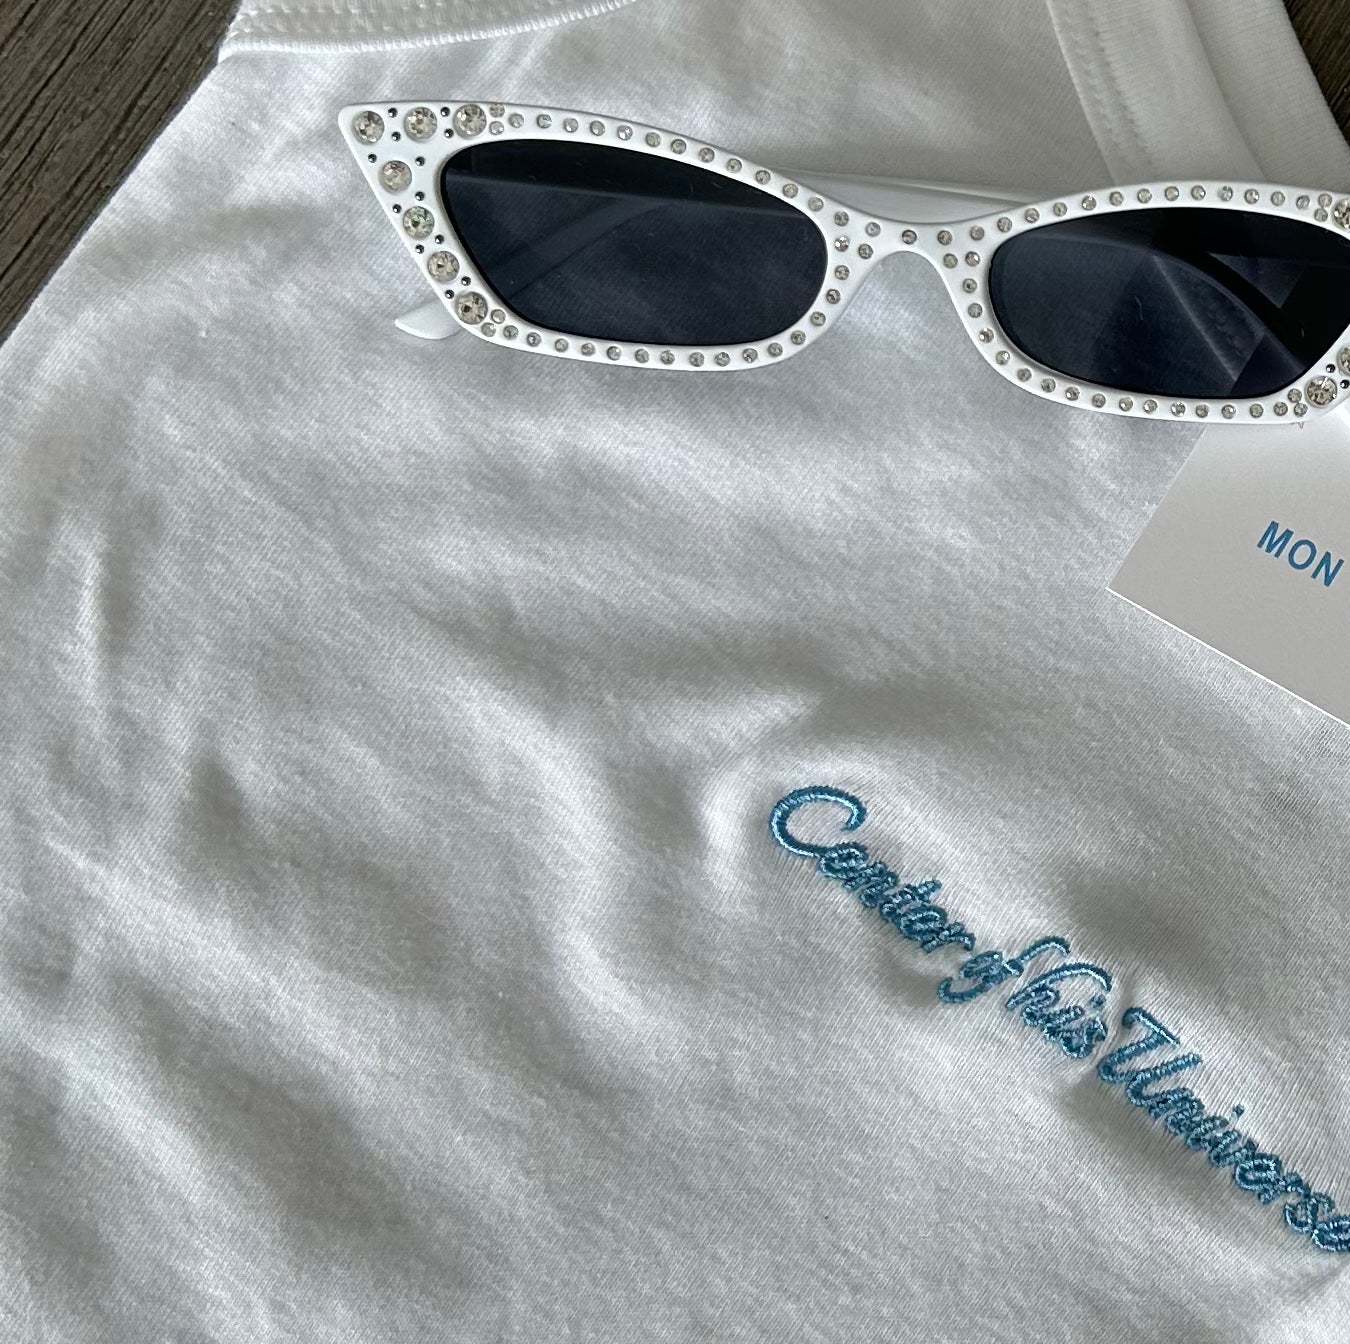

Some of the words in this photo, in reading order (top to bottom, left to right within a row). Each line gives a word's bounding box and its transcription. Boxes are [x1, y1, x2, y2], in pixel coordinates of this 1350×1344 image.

[1257, 521, 1344, 587] MON
[769, 785, 975, 953] Center
[938, 935, 1070, 1004] of
[1005, 962, 1112, 1058] his
